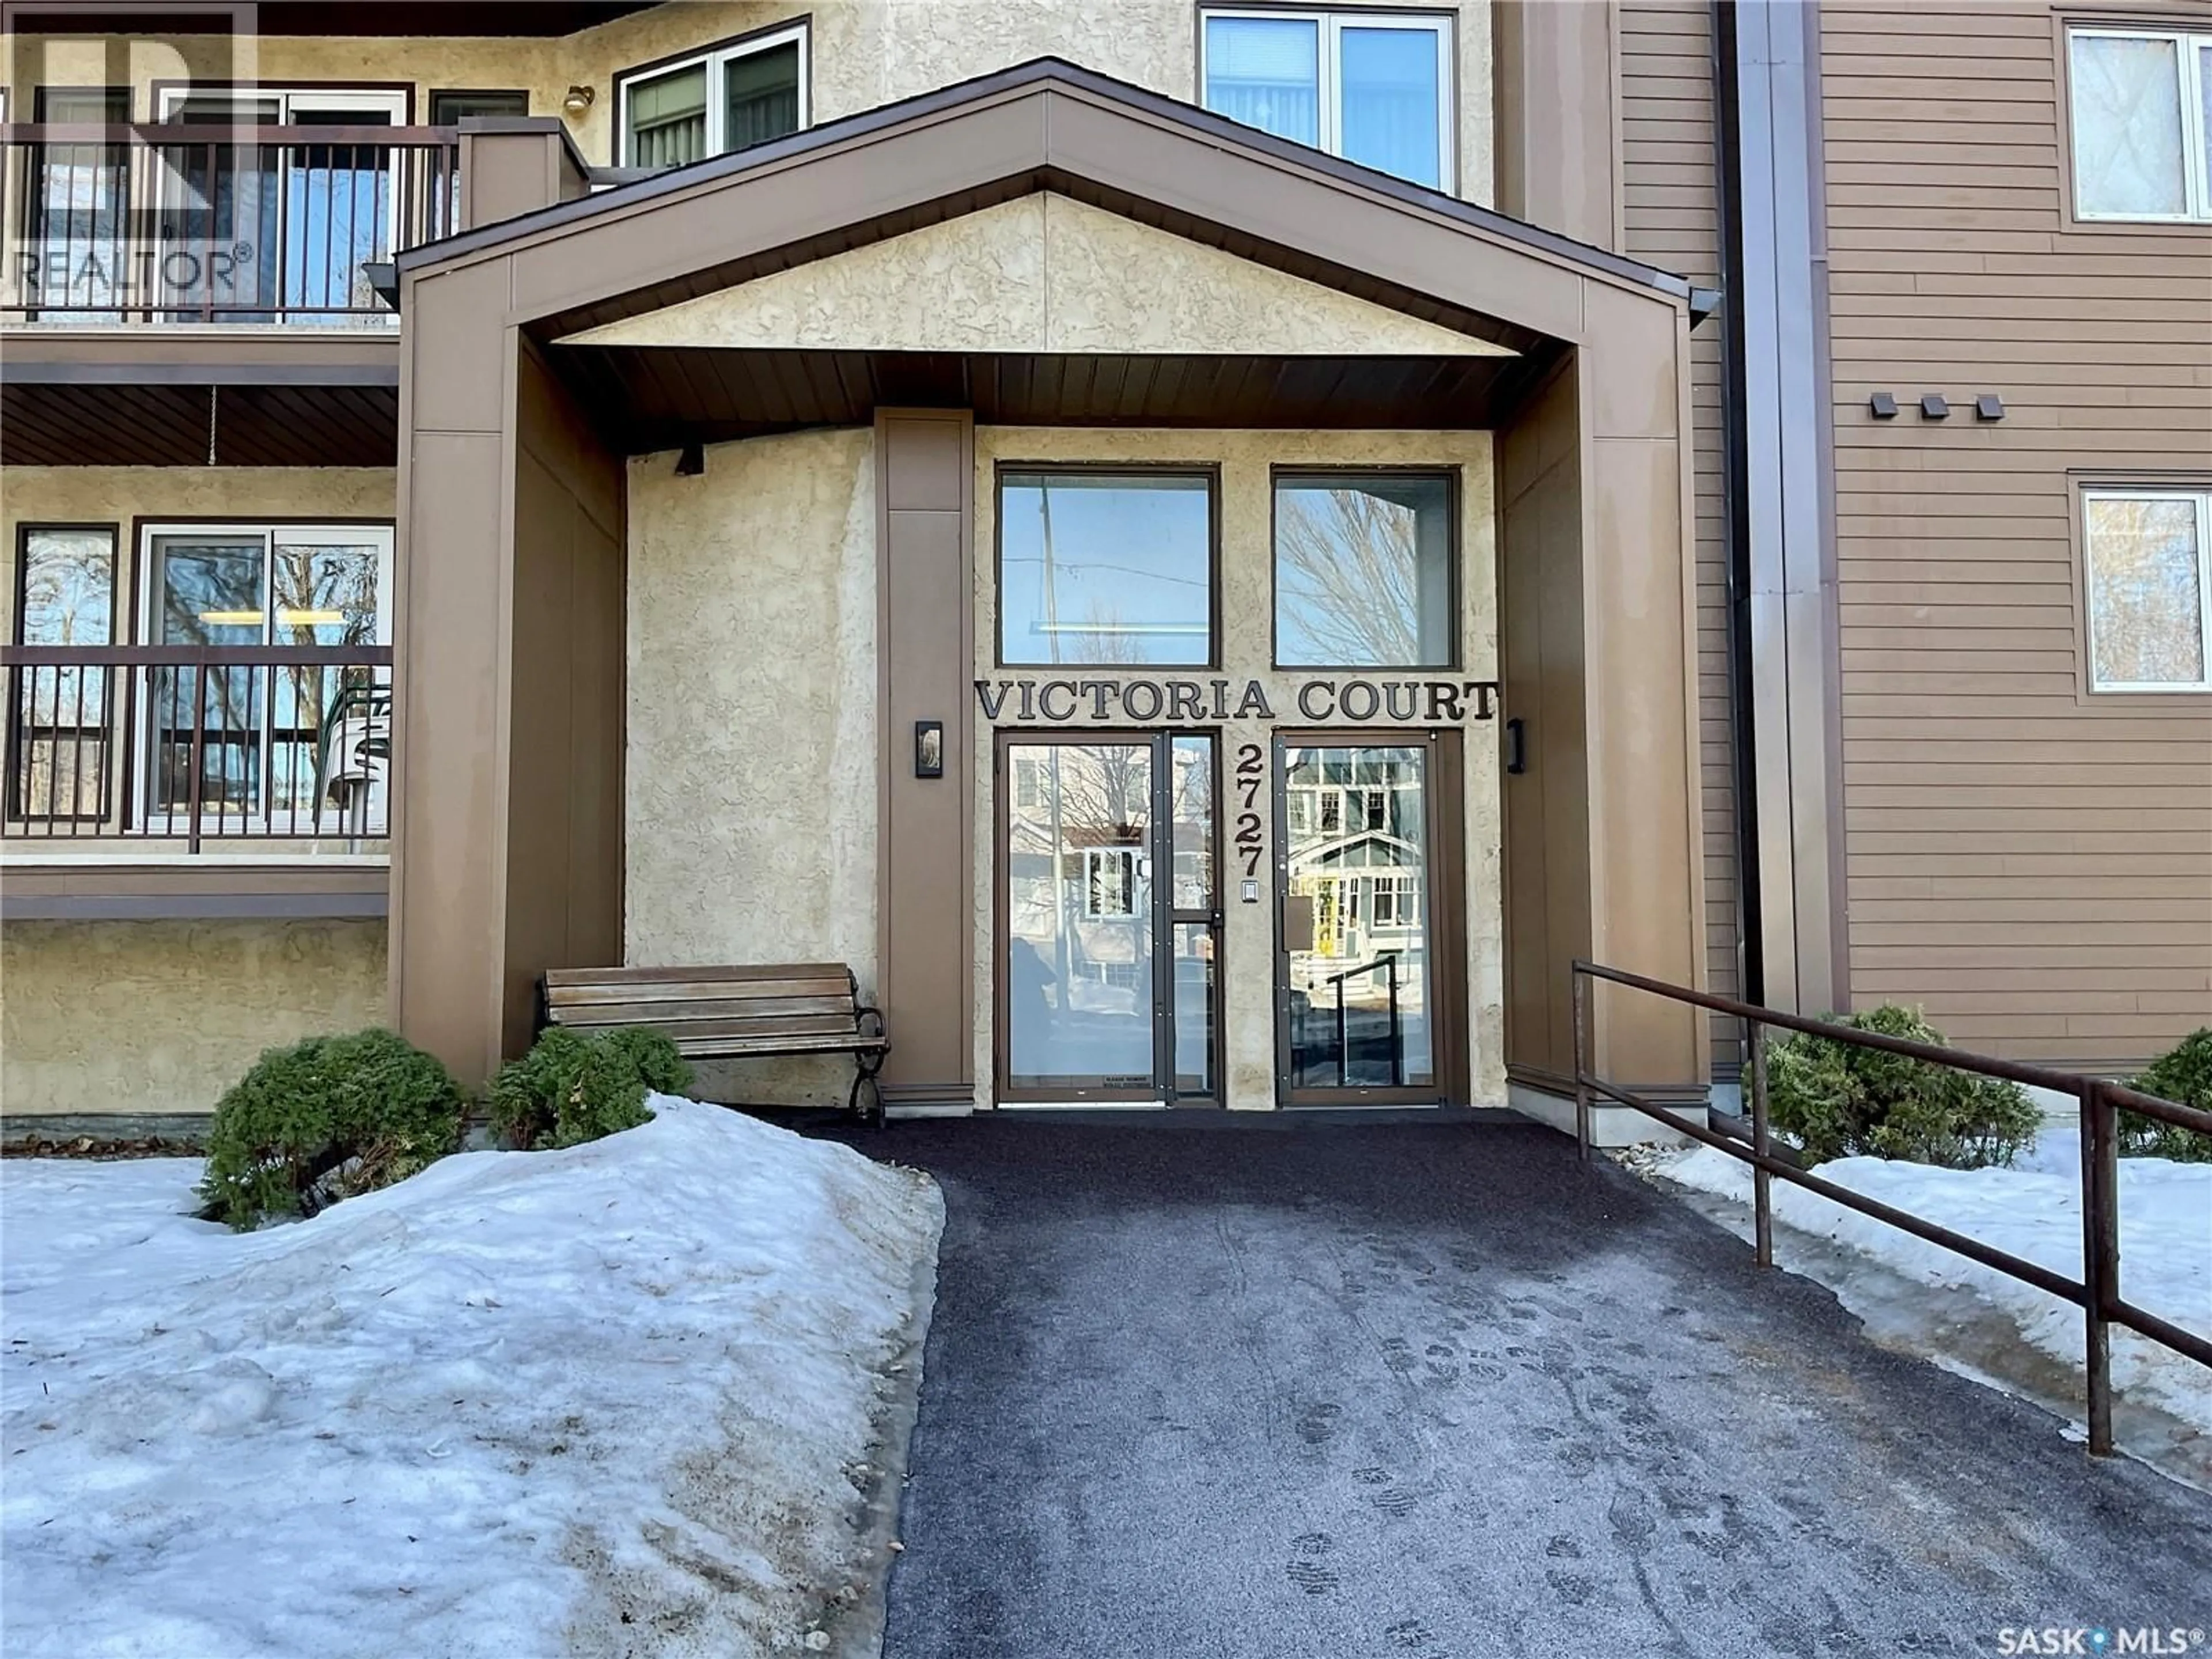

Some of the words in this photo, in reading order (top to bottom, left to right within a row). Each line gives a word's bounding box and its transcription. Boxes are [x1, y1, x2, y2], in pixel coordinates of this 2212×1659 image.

[974, 680, 1275, 720] VICTORIA
[1297, 680, 1500, 720] COURT
[1234, 744, 1263, 876] 2727
